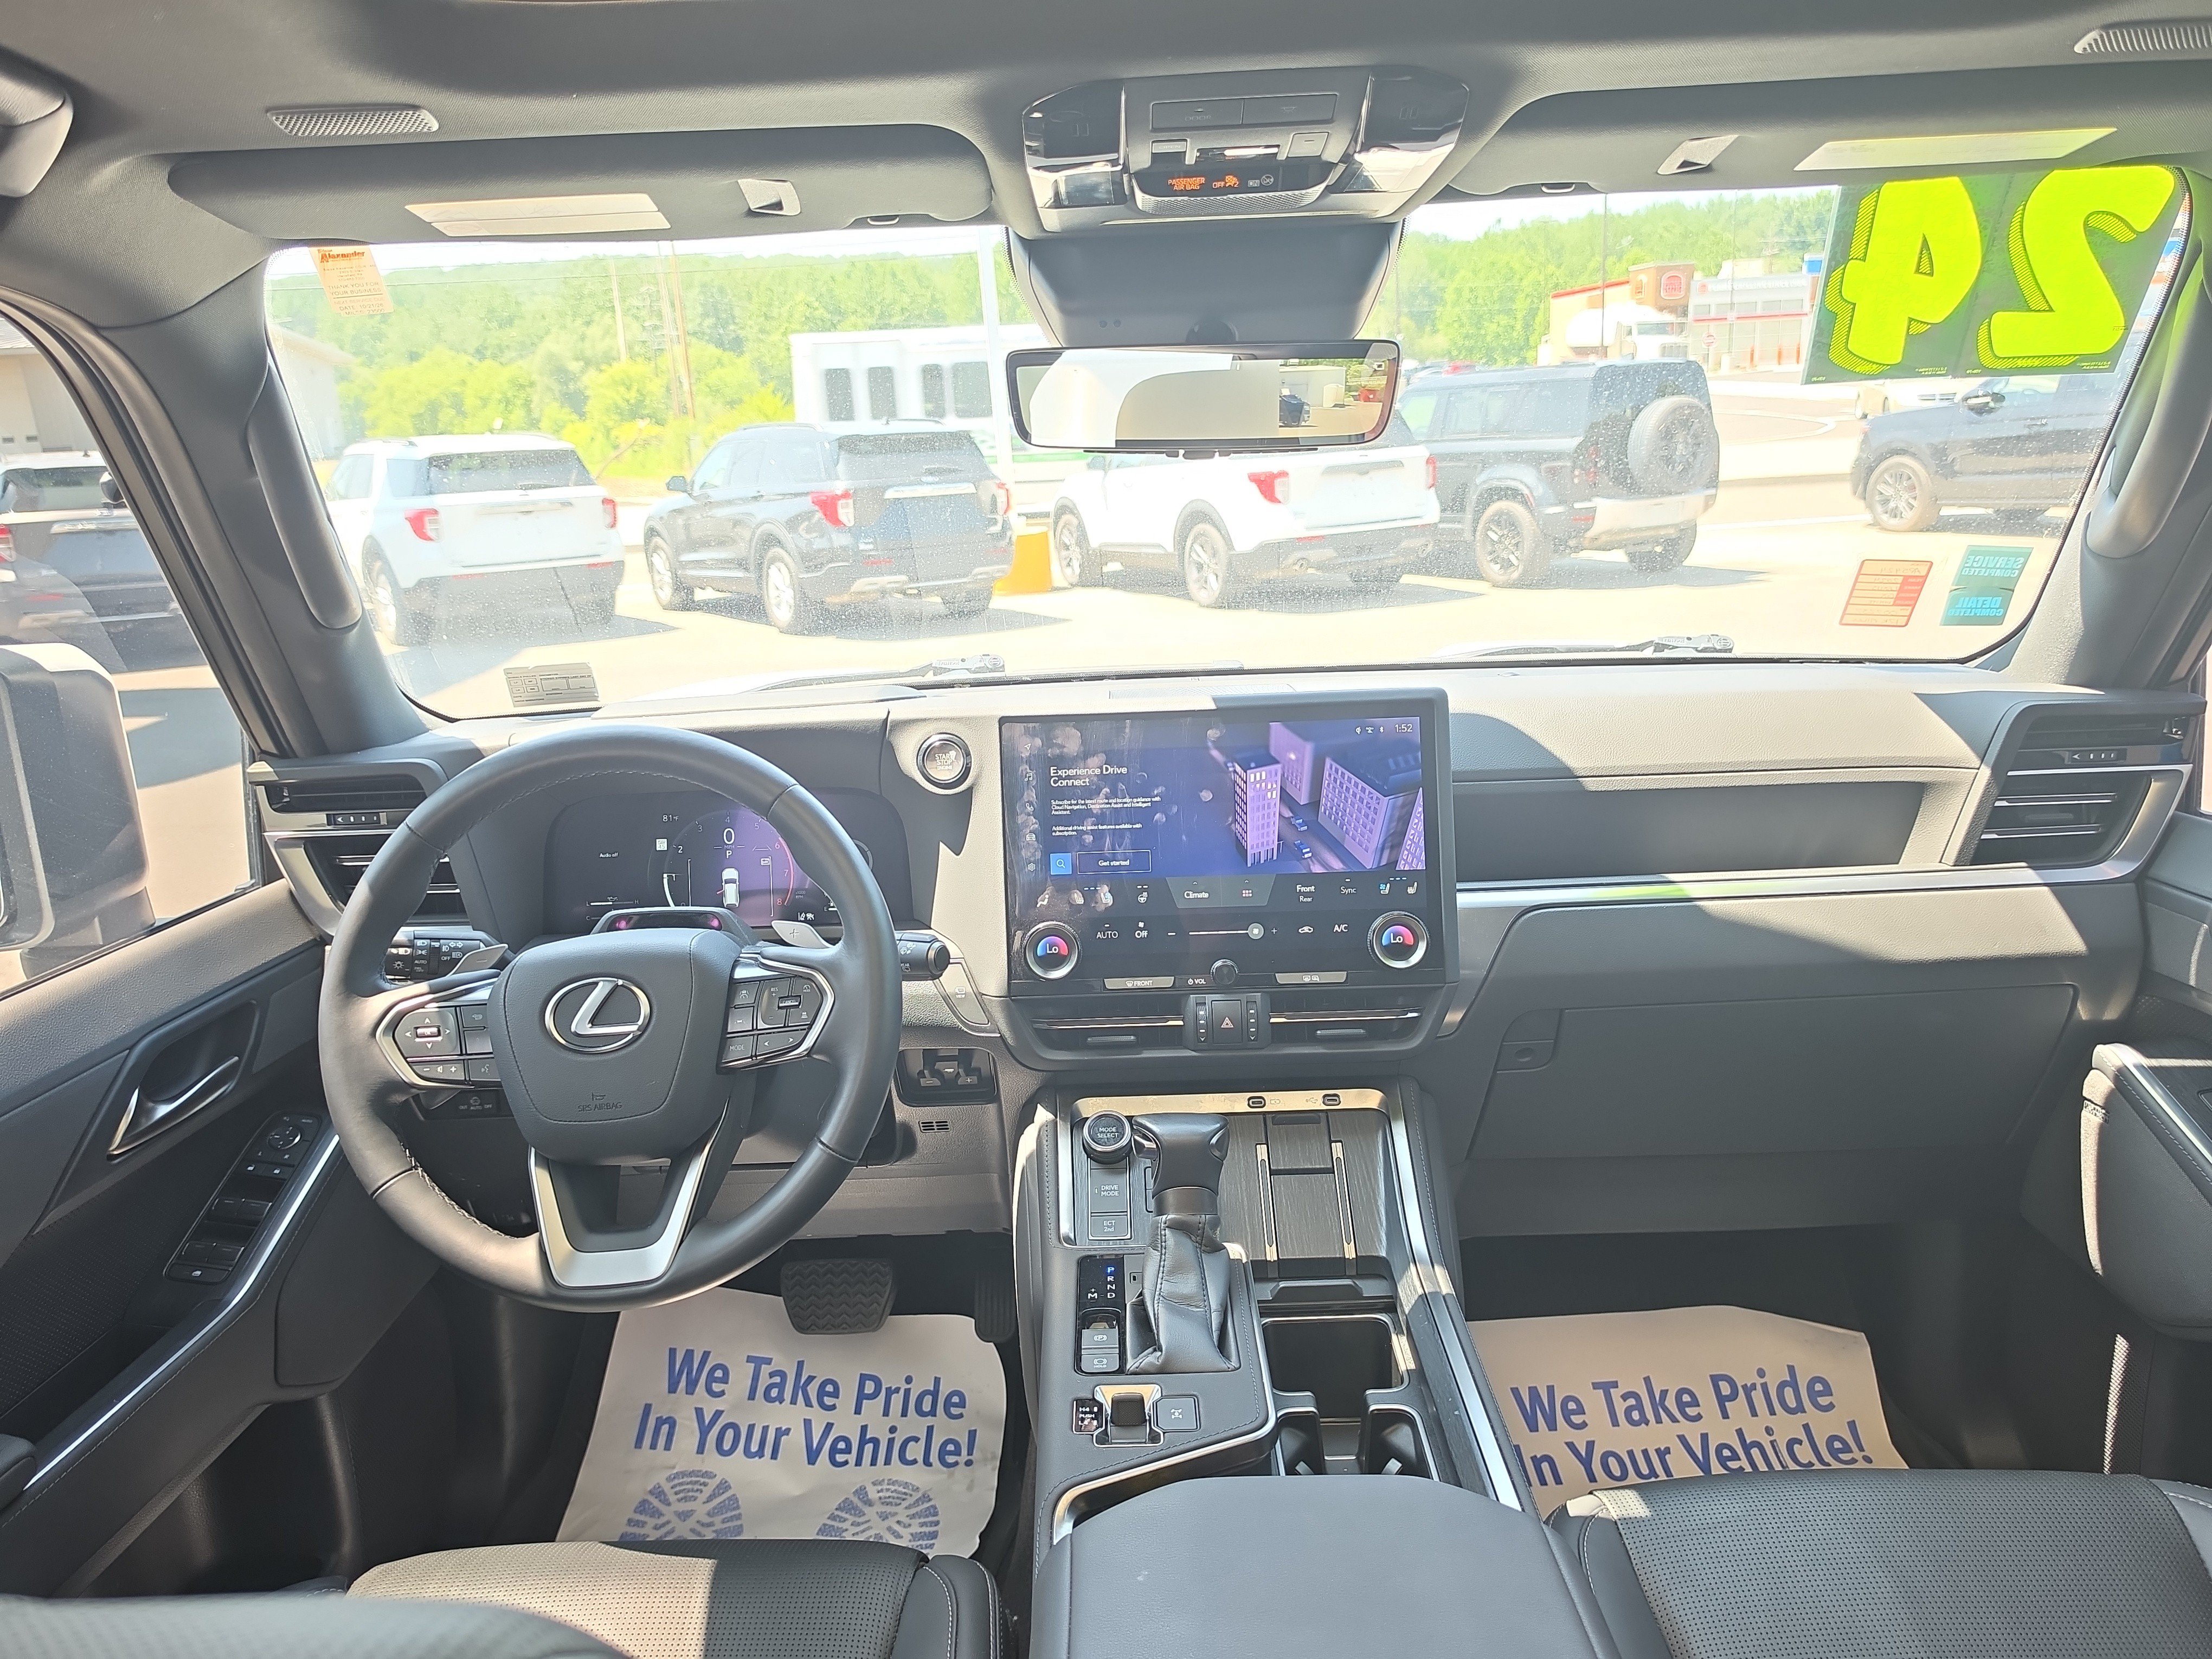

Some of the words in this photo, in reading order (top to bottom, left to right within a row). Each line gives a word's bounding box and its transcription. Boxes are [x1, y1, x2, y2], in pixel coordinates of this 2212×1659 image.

[1168, 177, 1205, 186] PASSENGER
[320, 251, 365, 263] Alexander
[1395, 724, 1413, 732] 1:52
[1050, 767, 1101, 777] Experience
[1103, 765, 1128, 774] Drive
[1050, 777, 1090, 787] Connect
[723, 828, 735, 844] 0
[726, 850, 732, 858] P
[1184, 891, 1209, 899] Climate
[1333, 924, 1348, 933] A/C
[1391, 933, 1403, 943] Lo
[1046, 943, 1059, 954] Lo
[594, 1102, 622, 1111] AIRBAG
[666, 1347, 730, 1398] We
[745, 1354, 840, 1411] Take
[853, 1372, 967, 1420] Pride
[1510, 1384, 1589, 1433] We
[1591, 1375, 1703, 1428] Take
[1708, 1364, 1836, 1419] Pride
[633, 1403, 677, 1452] In
[693, 1406, 790, 1461] Your
[802, 1418, 978, 1469] Vehicle!
[1515, 1444, 1563, 1488] In
[1565, 1439, 1673, 1484] Your
[1677, 1419, 1874, 1475] Vehicle!
